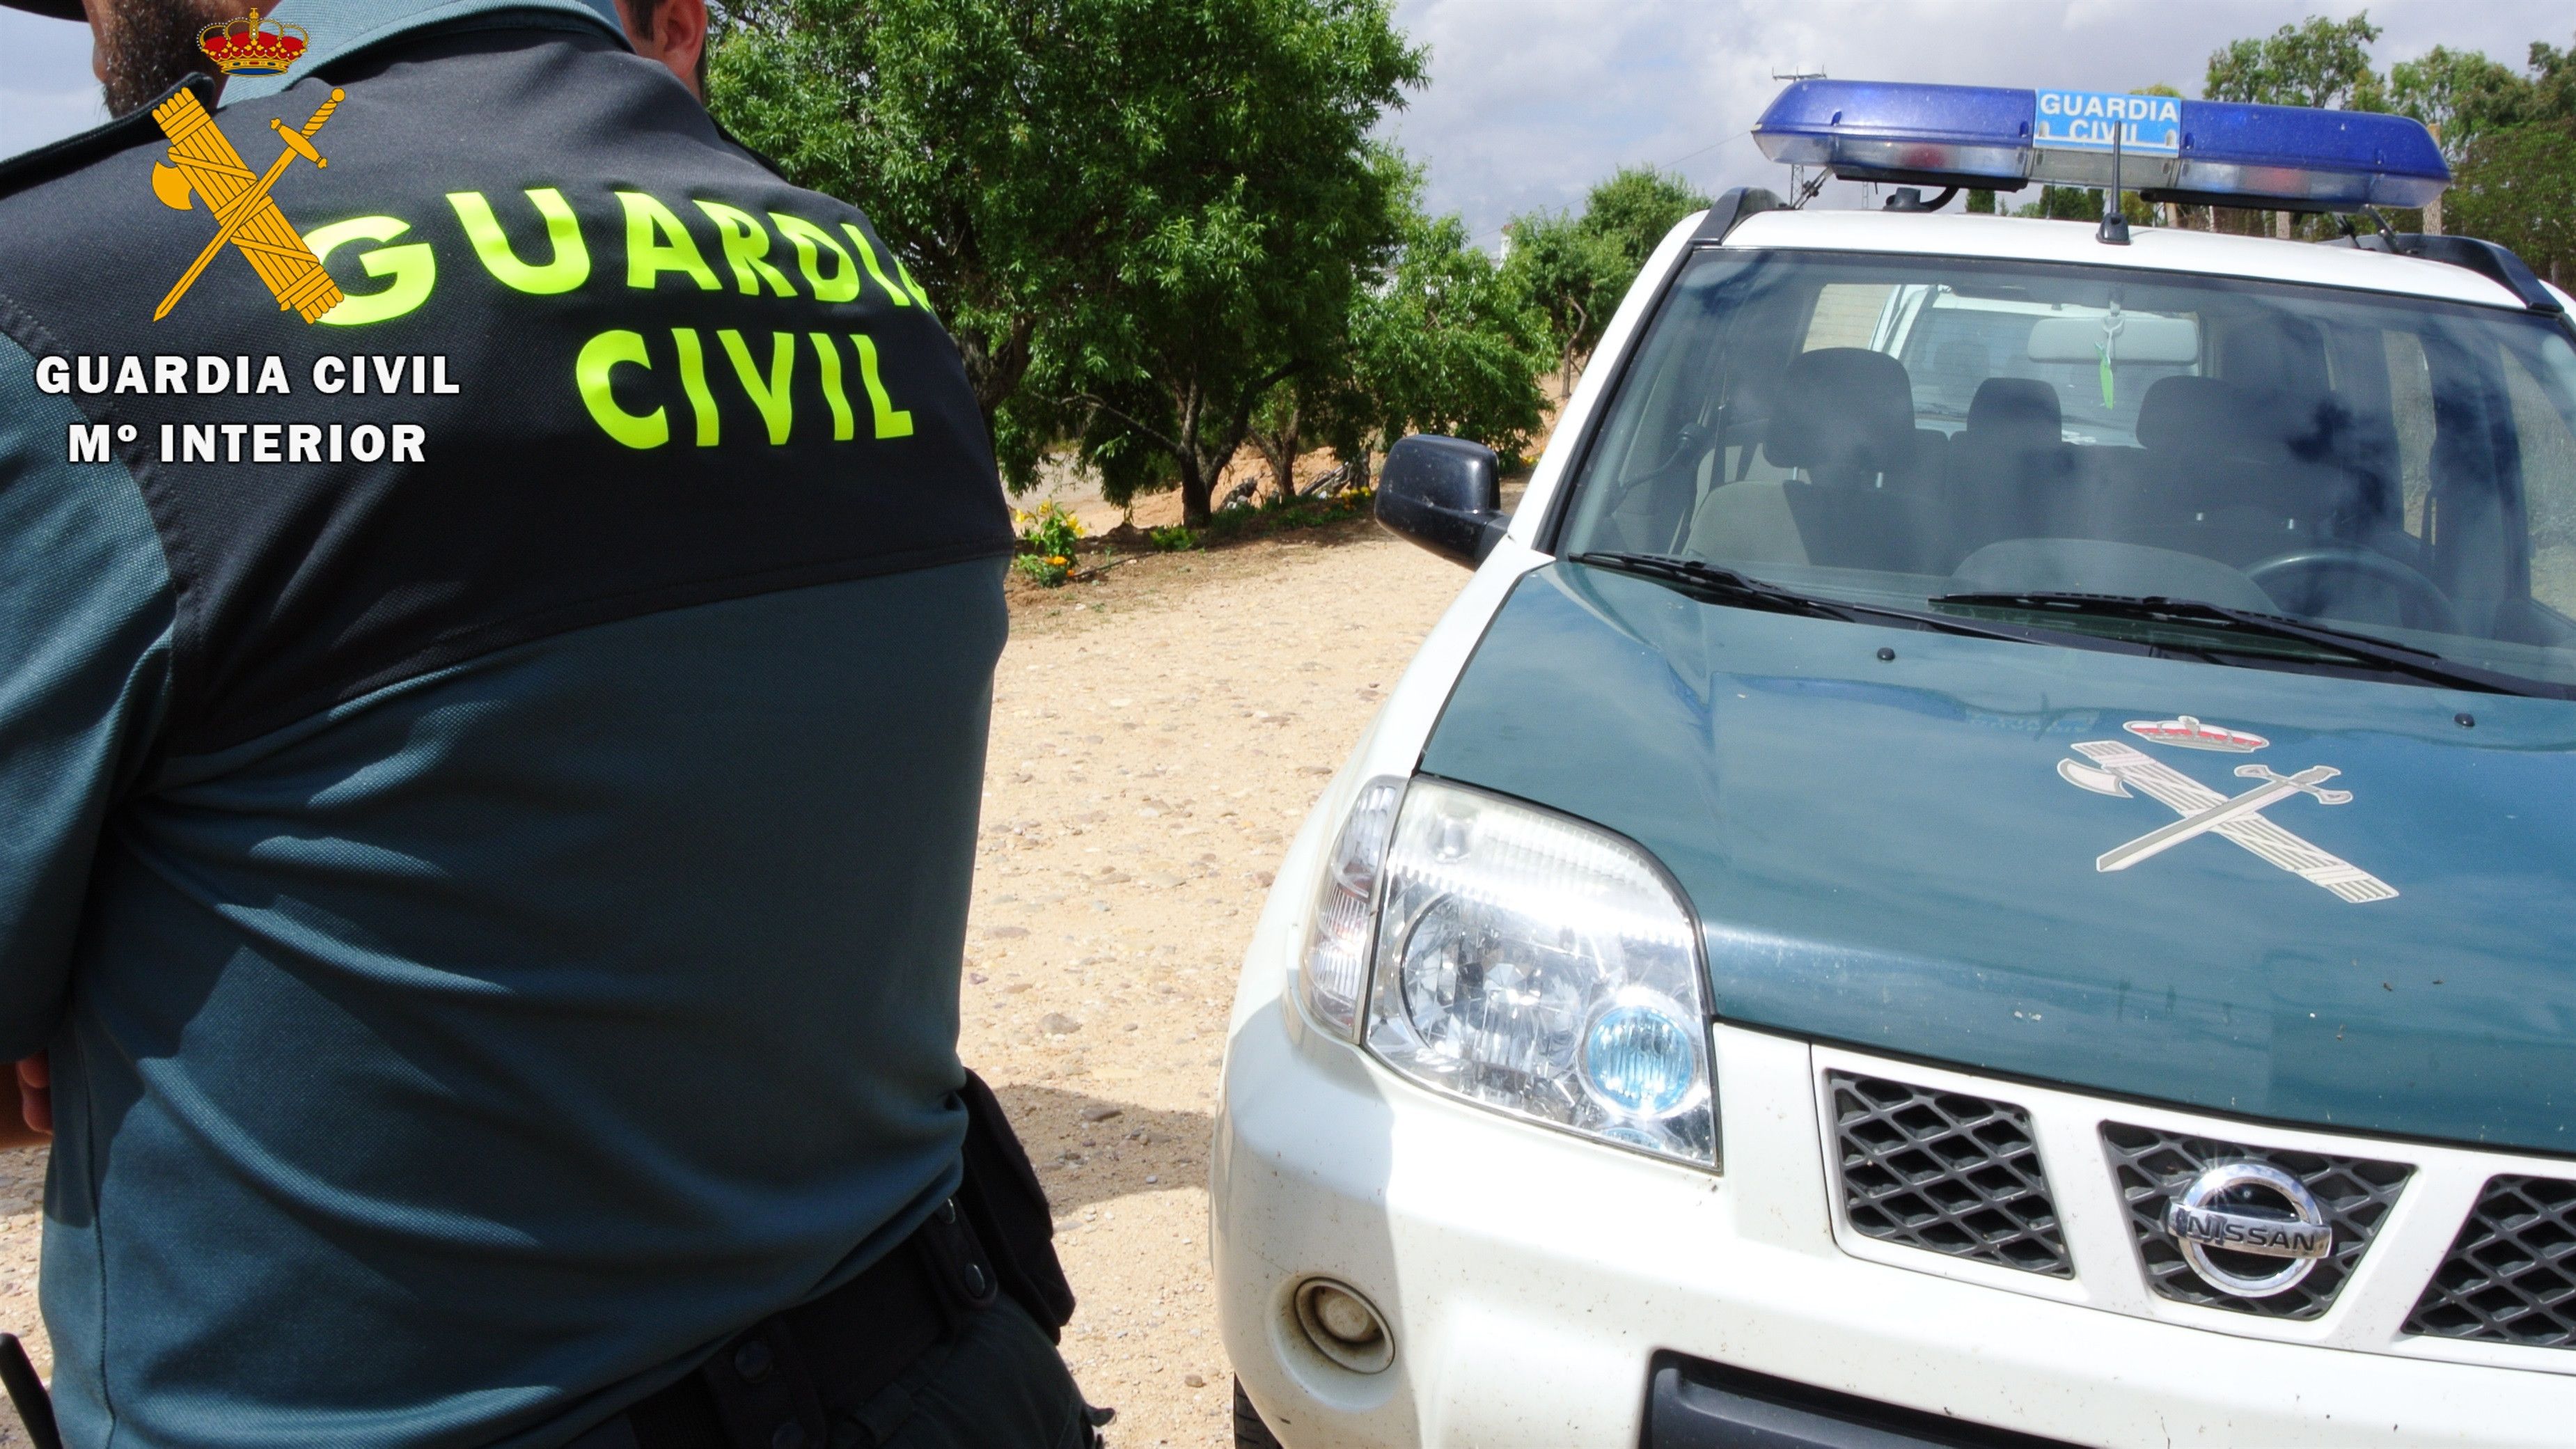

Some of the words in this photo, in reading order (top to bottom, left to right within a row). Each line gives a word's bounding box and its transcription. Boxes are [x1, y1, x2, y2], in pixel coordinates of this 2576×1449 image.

[2040, 93, 2178, 123] GUARDIA
[2068, 119, 2138, 143] CIVIL
[576, 327, 914, 449] CIVIL
[2188, 1215, 2315, 1252] NISSAN
